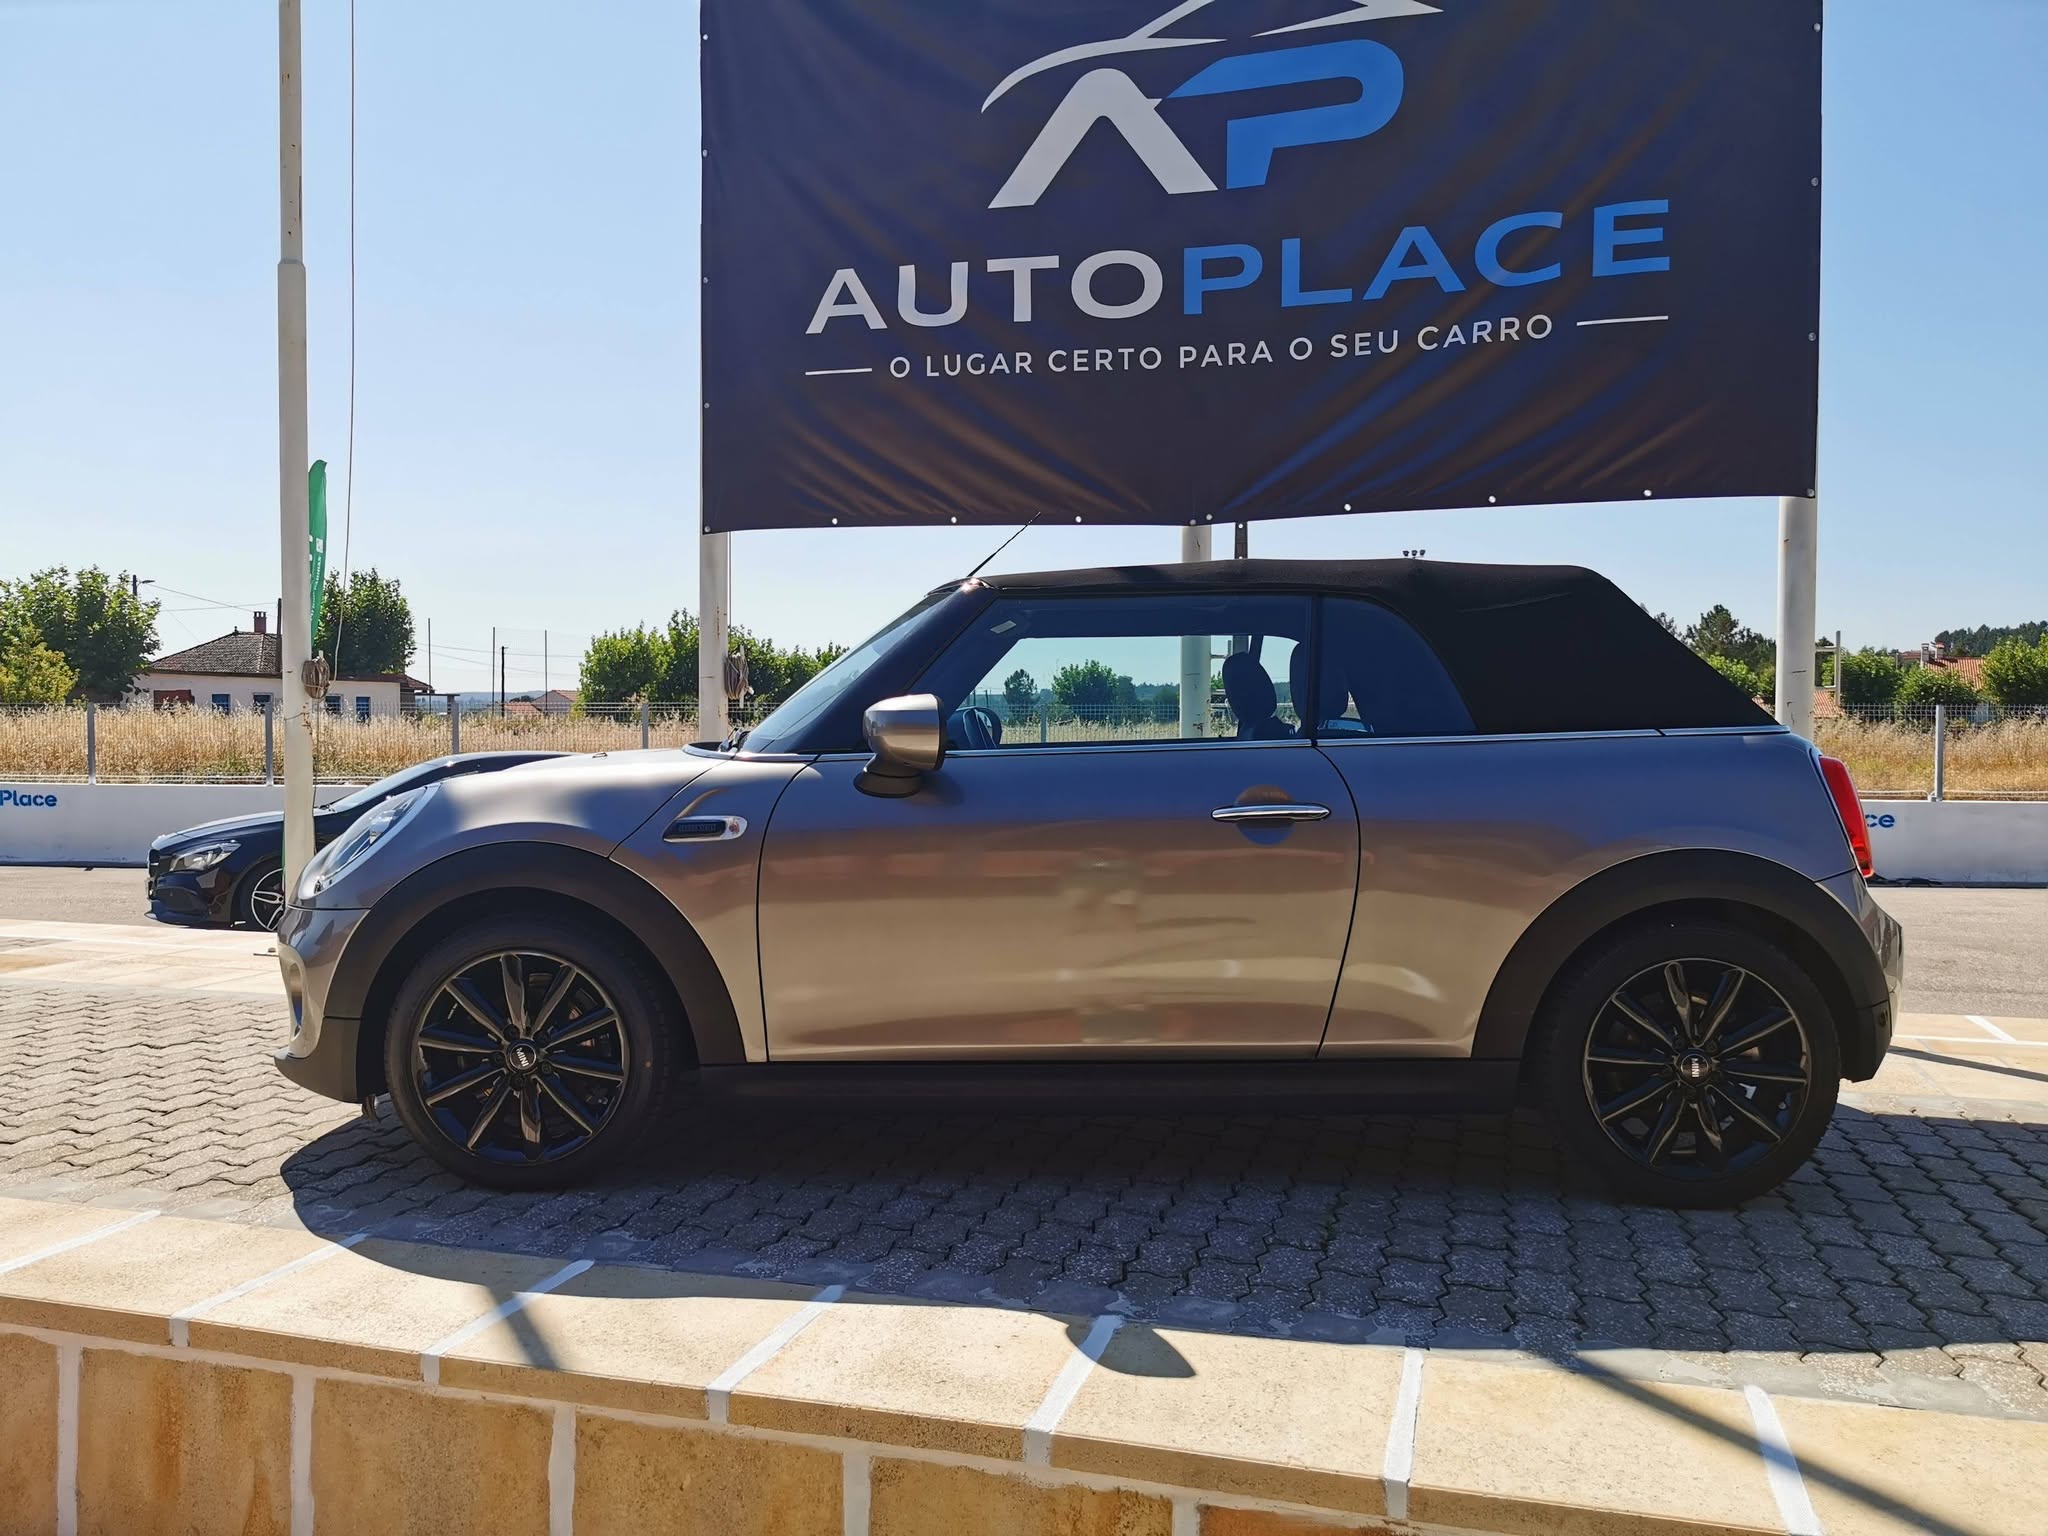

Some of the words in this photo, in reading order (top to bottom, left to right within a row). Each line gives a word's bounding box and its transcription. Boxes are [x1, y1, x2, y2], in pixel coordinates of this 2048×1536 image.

[805, 199, 1670, 335] AUTOPLACE
[889, 356, 911, 378] O
[925, 351, 1034, 377] LUGAR
[1047, 346, 1162, 372] CERTO
[1178, 340, 1274, 369] PARA
[1289, 337, 1313, 361] O
[1330, 329, 1400, 358] SEU
[1417, 314, 1553, 351] CARRO
[516, 1047, 530, 1067] MINI
[1691, 1058, 1700, 1078] MINI
